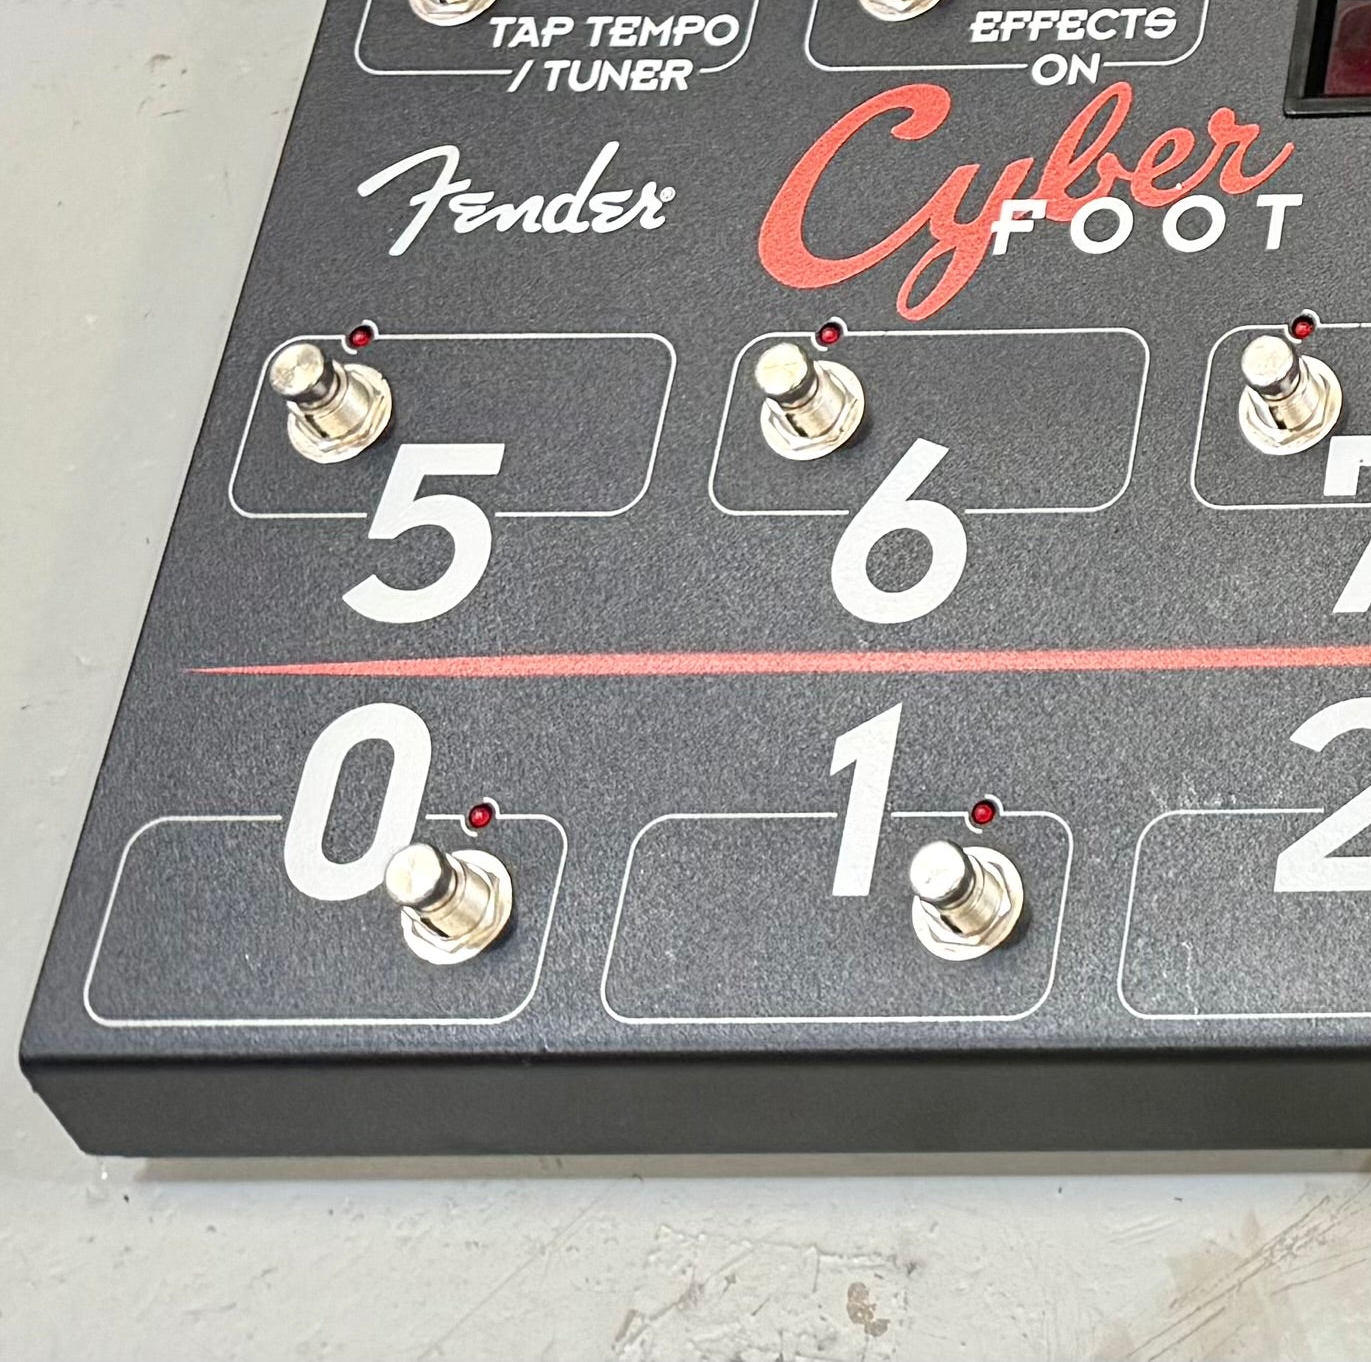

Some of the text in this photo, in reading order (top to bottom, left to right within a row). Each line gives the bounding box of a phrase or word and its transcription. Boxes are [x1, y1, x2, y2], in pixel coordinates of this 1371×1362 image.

[489, 13, 741, 50] TAP TEMPO
[542, 58, 693, 93] TUNER
[968, 6, 1177, 42] EFFECTS
[1031, 50, 1103, 87] ON
[757, 81, 1295, 322] Cyber
[990, 193, 1303, 256] FOOT
[341, 442, 505, 625] 5
[830, 438, 968, 625] 6
[284, 702, 432, 902] 0
[830, 701, 903, 898] 1
